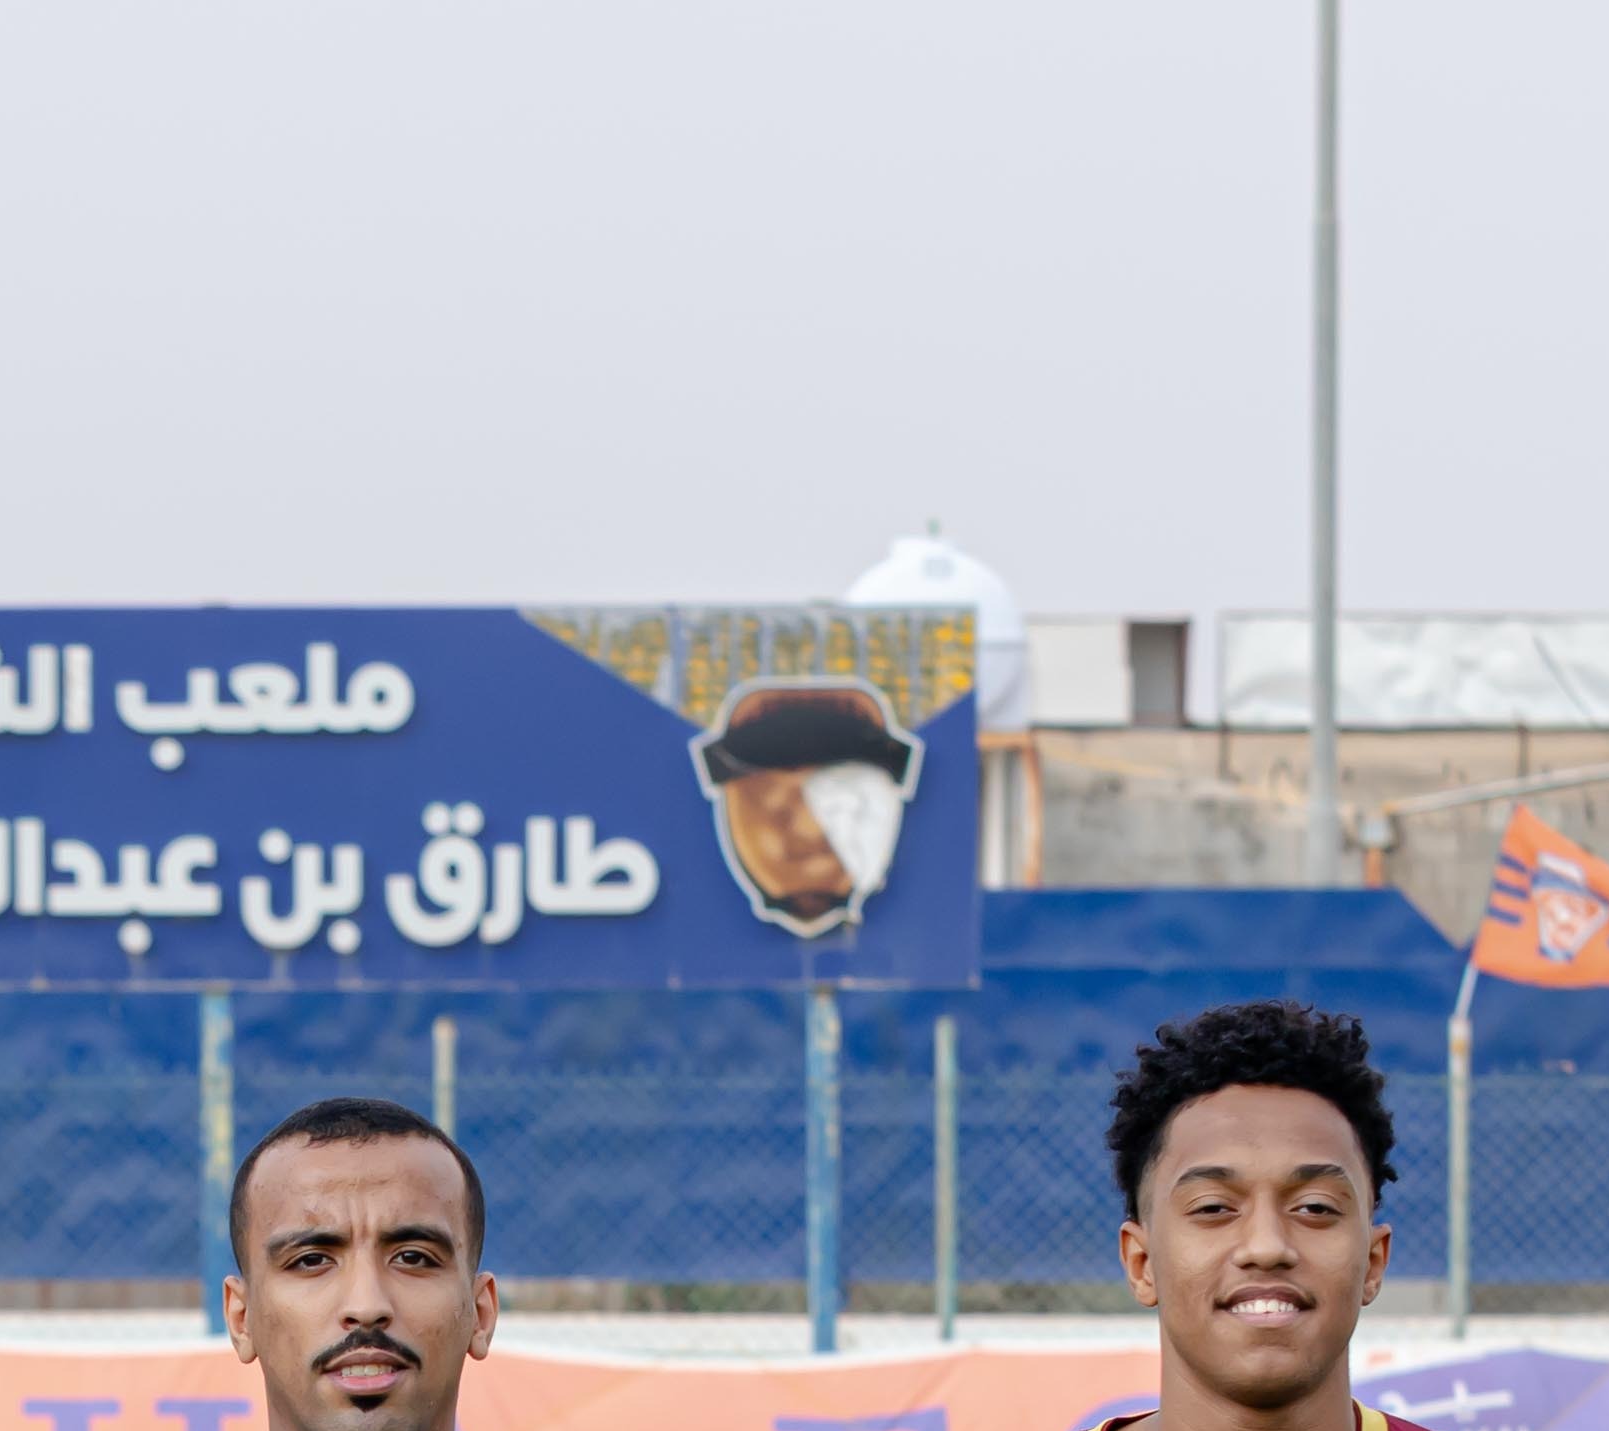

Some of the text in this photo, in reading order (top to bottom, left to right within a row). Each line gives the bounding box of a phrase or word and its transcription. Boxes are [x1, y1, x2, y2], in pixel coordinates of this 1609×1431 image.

[115, 641, 414, 770] ملعب
[240, 829, 362, 953] بن
[385, 802, 659, 946] طارق
